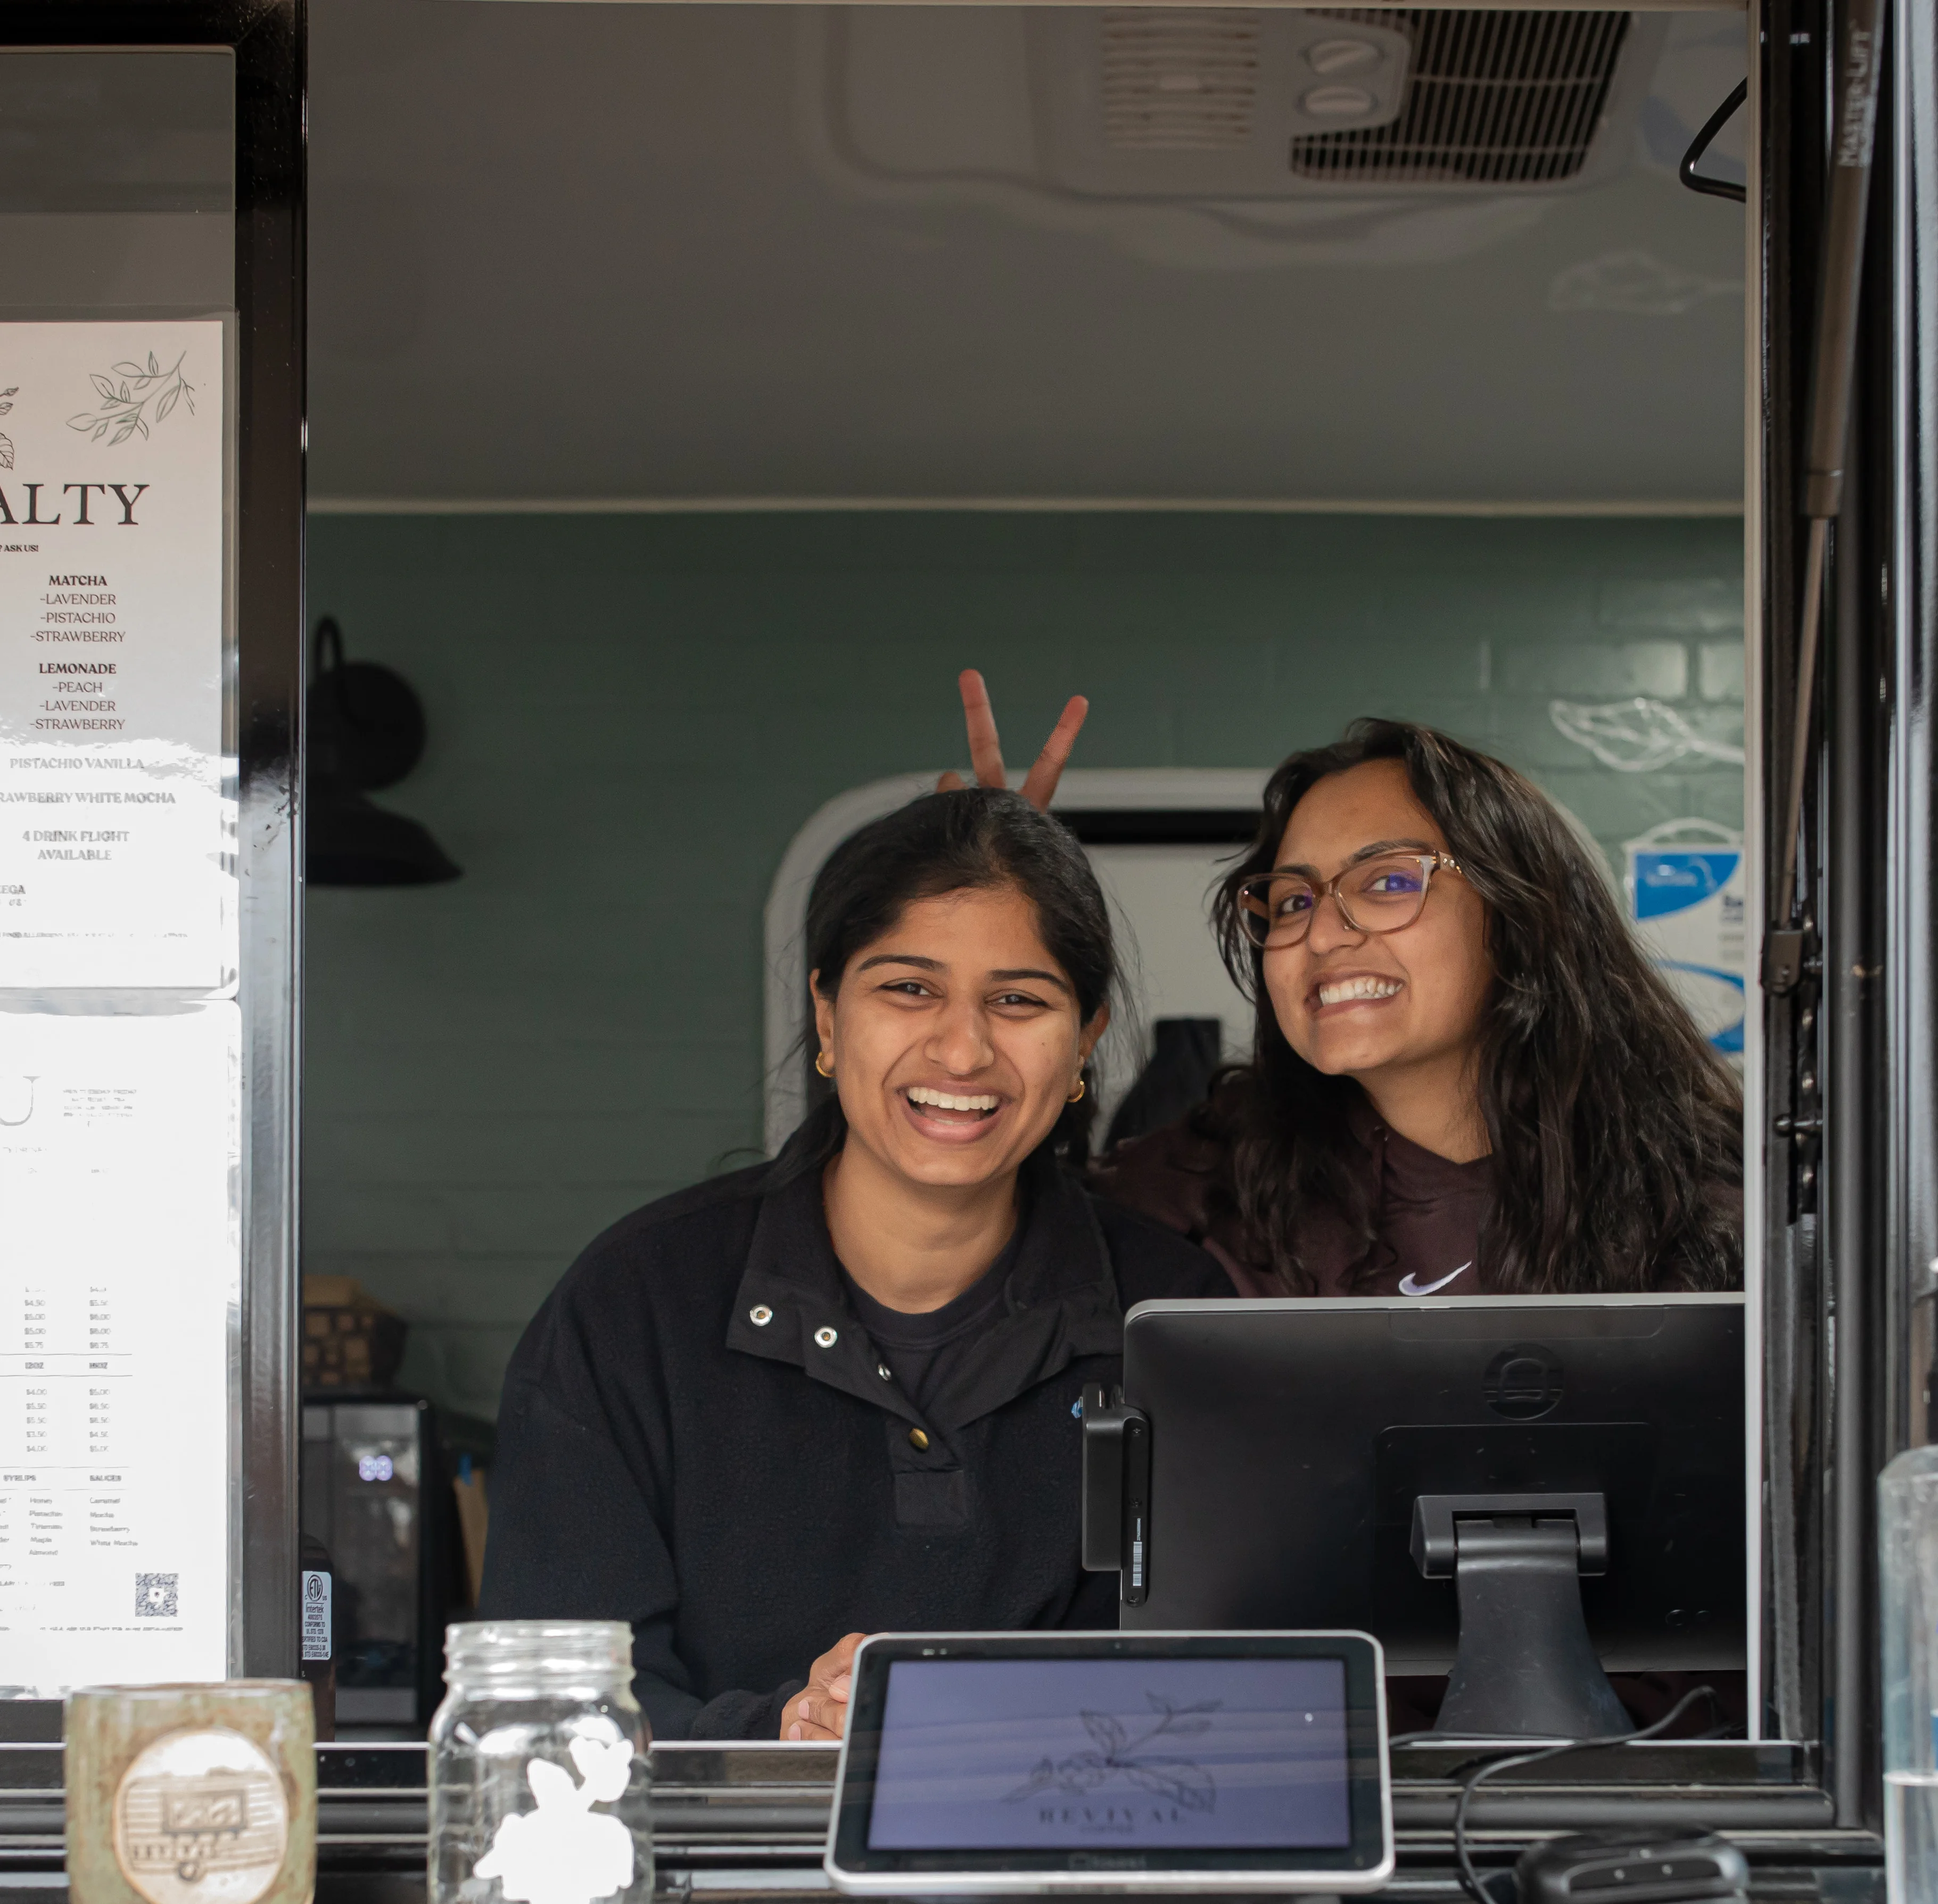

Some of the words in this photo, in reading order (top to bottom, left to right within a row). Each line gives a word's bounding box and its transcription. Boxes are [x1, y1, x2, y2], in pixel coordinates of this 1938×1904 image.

[49, 575, 108, 586] MATCHA
[40, 594, 116, 605] -LAVENDER
[40, 612, 116, 624] -PISTACHIO
[30, 631, 126, 642] -STRAWBERRY
[39, 664, 117, 674] LEMONADE
[53, 682, 103, 692] -PEACH
[40, 700, 116, 711] -LAVENDER
[30, 719, 125, 730] -STRAWBERRY
[10, 758, 83, 769] PISTACHIO
[85, 758, 145, 769] VANILLA
[76, 792, 121, 804] WHITE
[125, 792, 176, 804] MOCHA
[22, 831, 30, 842] 4
[34, 830, 78, 842] DRINK
[80, 830, 130, 842] FLIGHT
[38, 849, 112, 860] AVAILABLE
